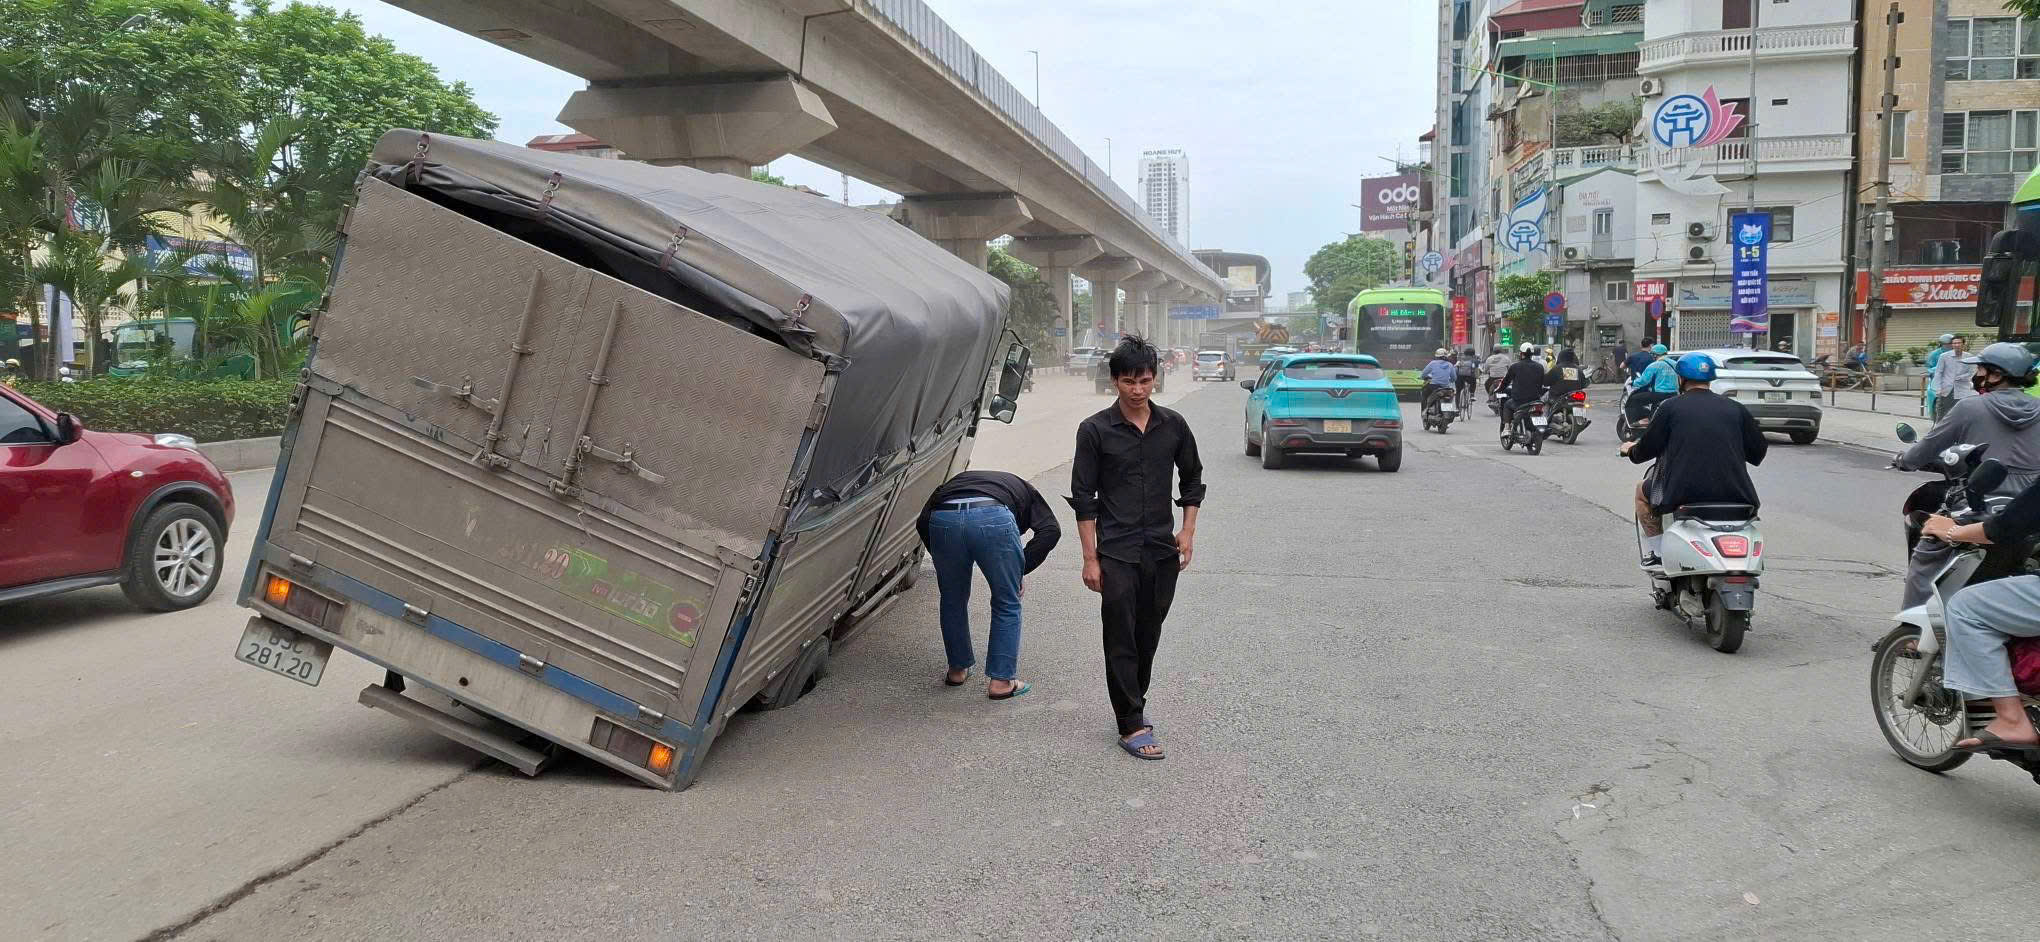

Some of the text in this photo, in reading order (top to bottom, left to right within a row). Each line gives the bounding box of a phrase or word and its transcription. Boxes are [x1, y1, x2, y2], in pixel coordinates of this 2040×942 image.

[1740, 246, 1759, 258] 1-5
[1636, 281, 1665, 296] XE MÁY
[245, 642, 313, 679] 281.20
